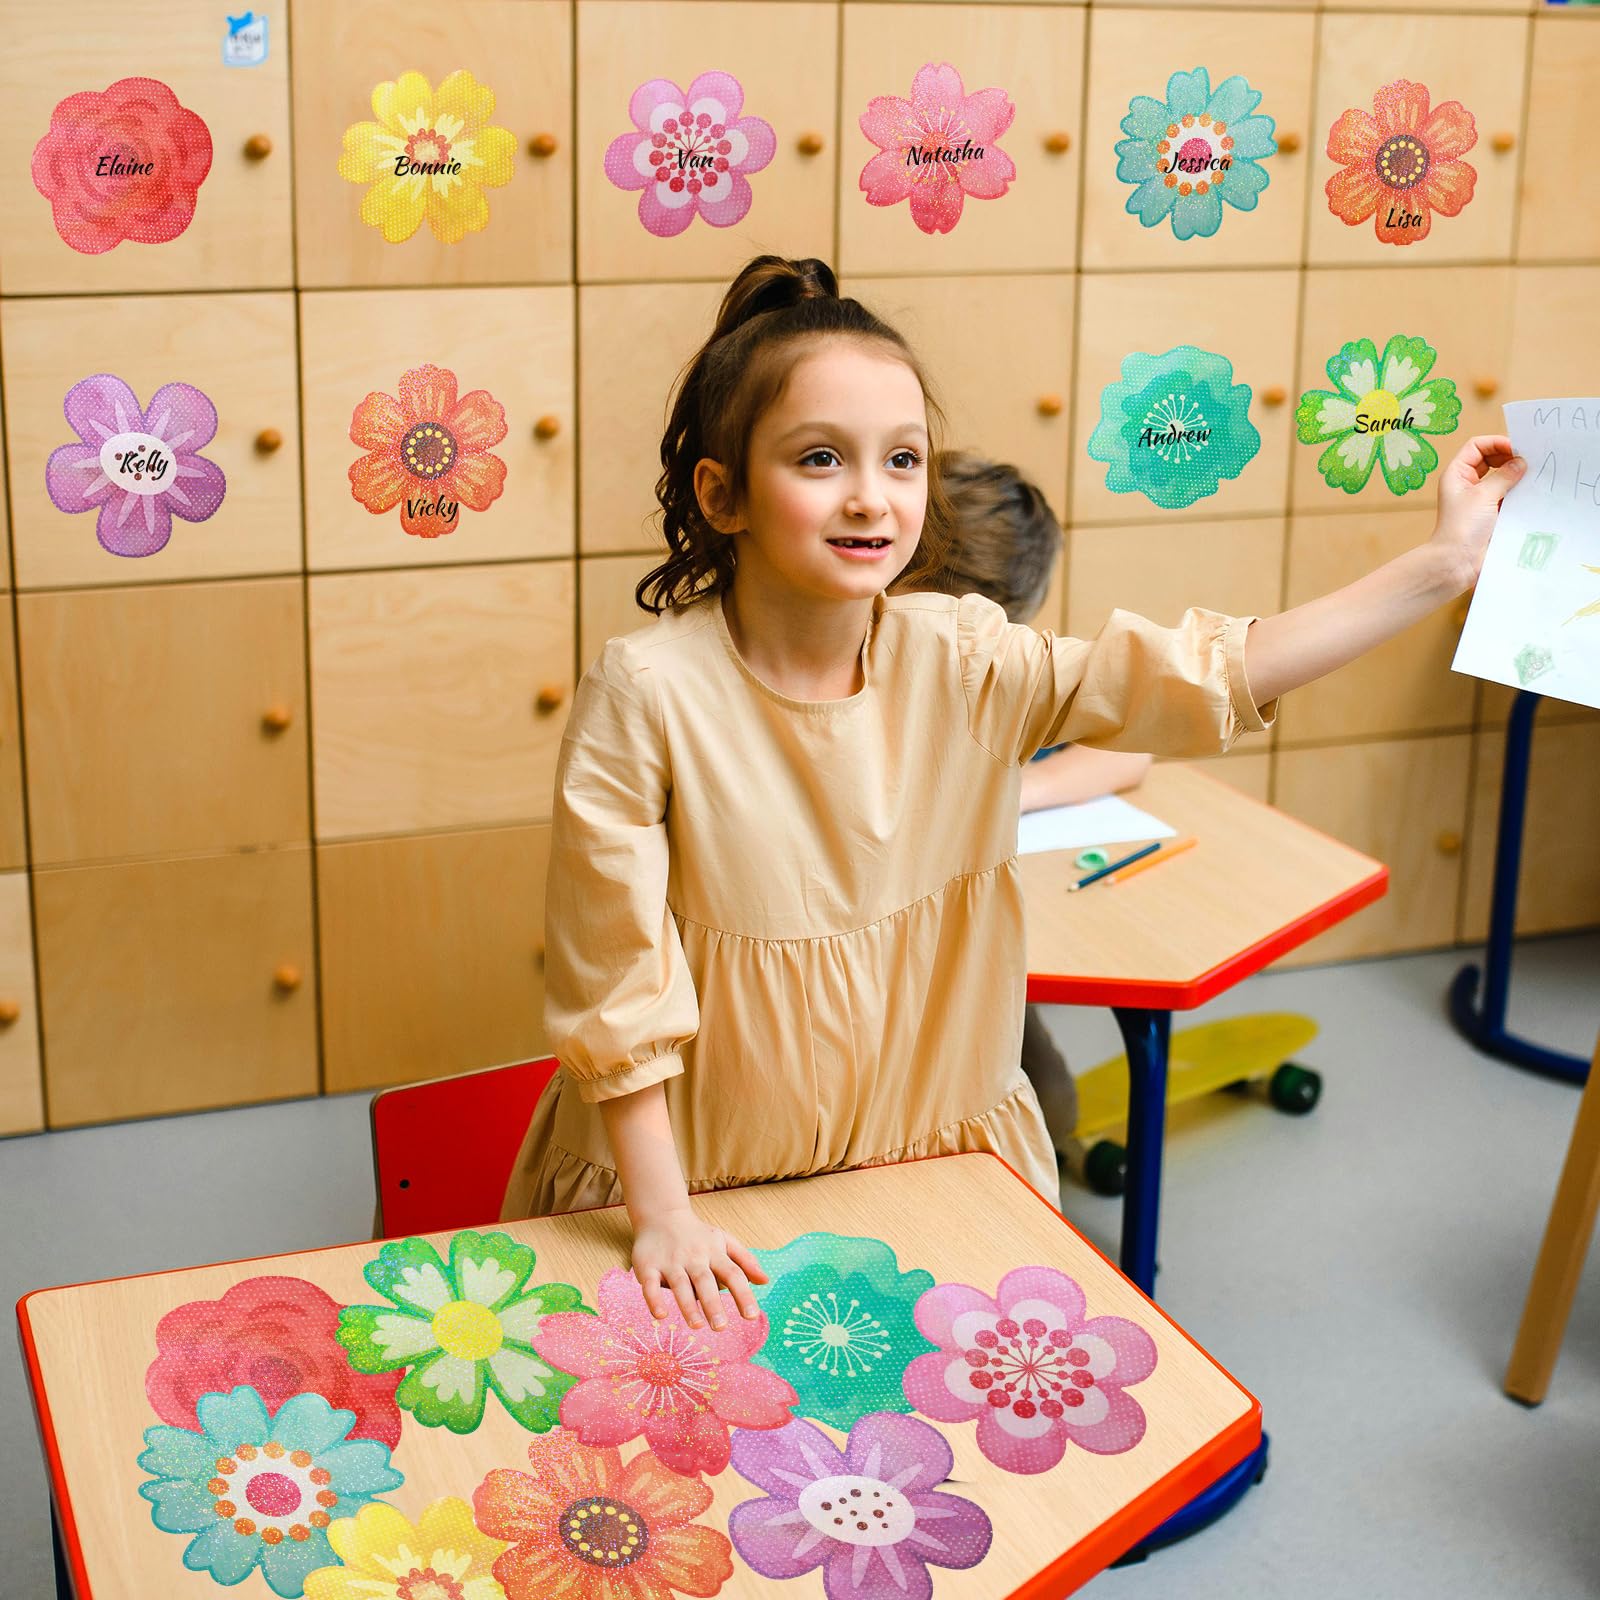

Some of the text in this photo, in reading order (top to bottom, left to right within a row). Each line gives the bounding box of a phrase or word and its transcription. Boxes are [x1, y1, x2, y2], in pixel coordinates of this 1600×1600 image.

[677, 149, 714, 170] Van
[906, 139, 985, 166] Natasha
[1163, 151, 1230, 174] Jessica
[95, 153, 154, 177] Elaine
[394, 155, 462, 177] Bonnie
[1385, 207, 1423, 229] Lisa
[1353, 408, 1415, 434] Sarah
[1138, 423, 1213, 448] Andrew
[119, 449, 169, 481] Kelly
[407, 494, 459, 523] Vicky
